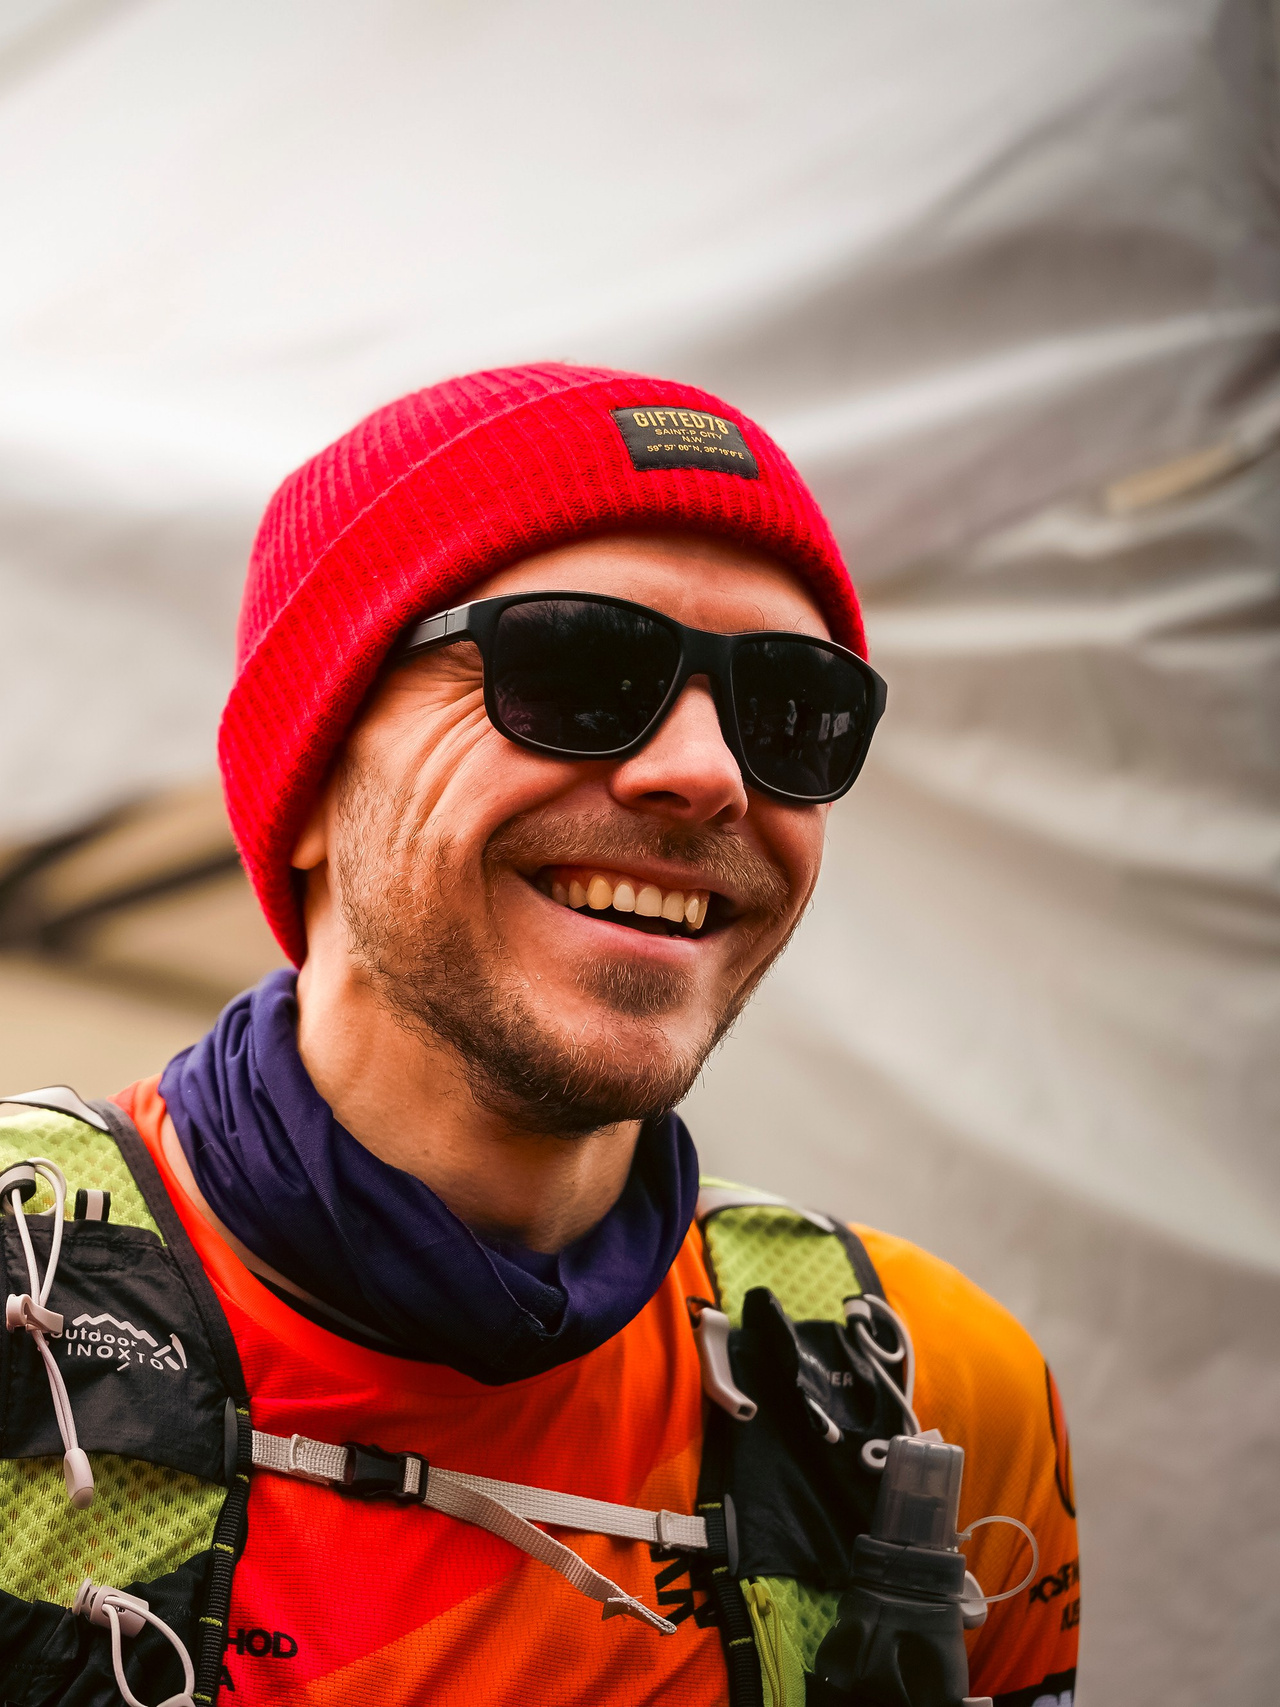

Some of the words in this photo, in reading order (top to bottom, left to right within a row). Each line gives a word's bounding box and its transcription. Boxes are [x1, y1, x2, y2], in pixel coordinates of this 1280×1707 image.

[632, 411, 729, 435] GIFTED78
[681, 435, 706, 444] N.W.
[699, 430, 722, 440] CITY
